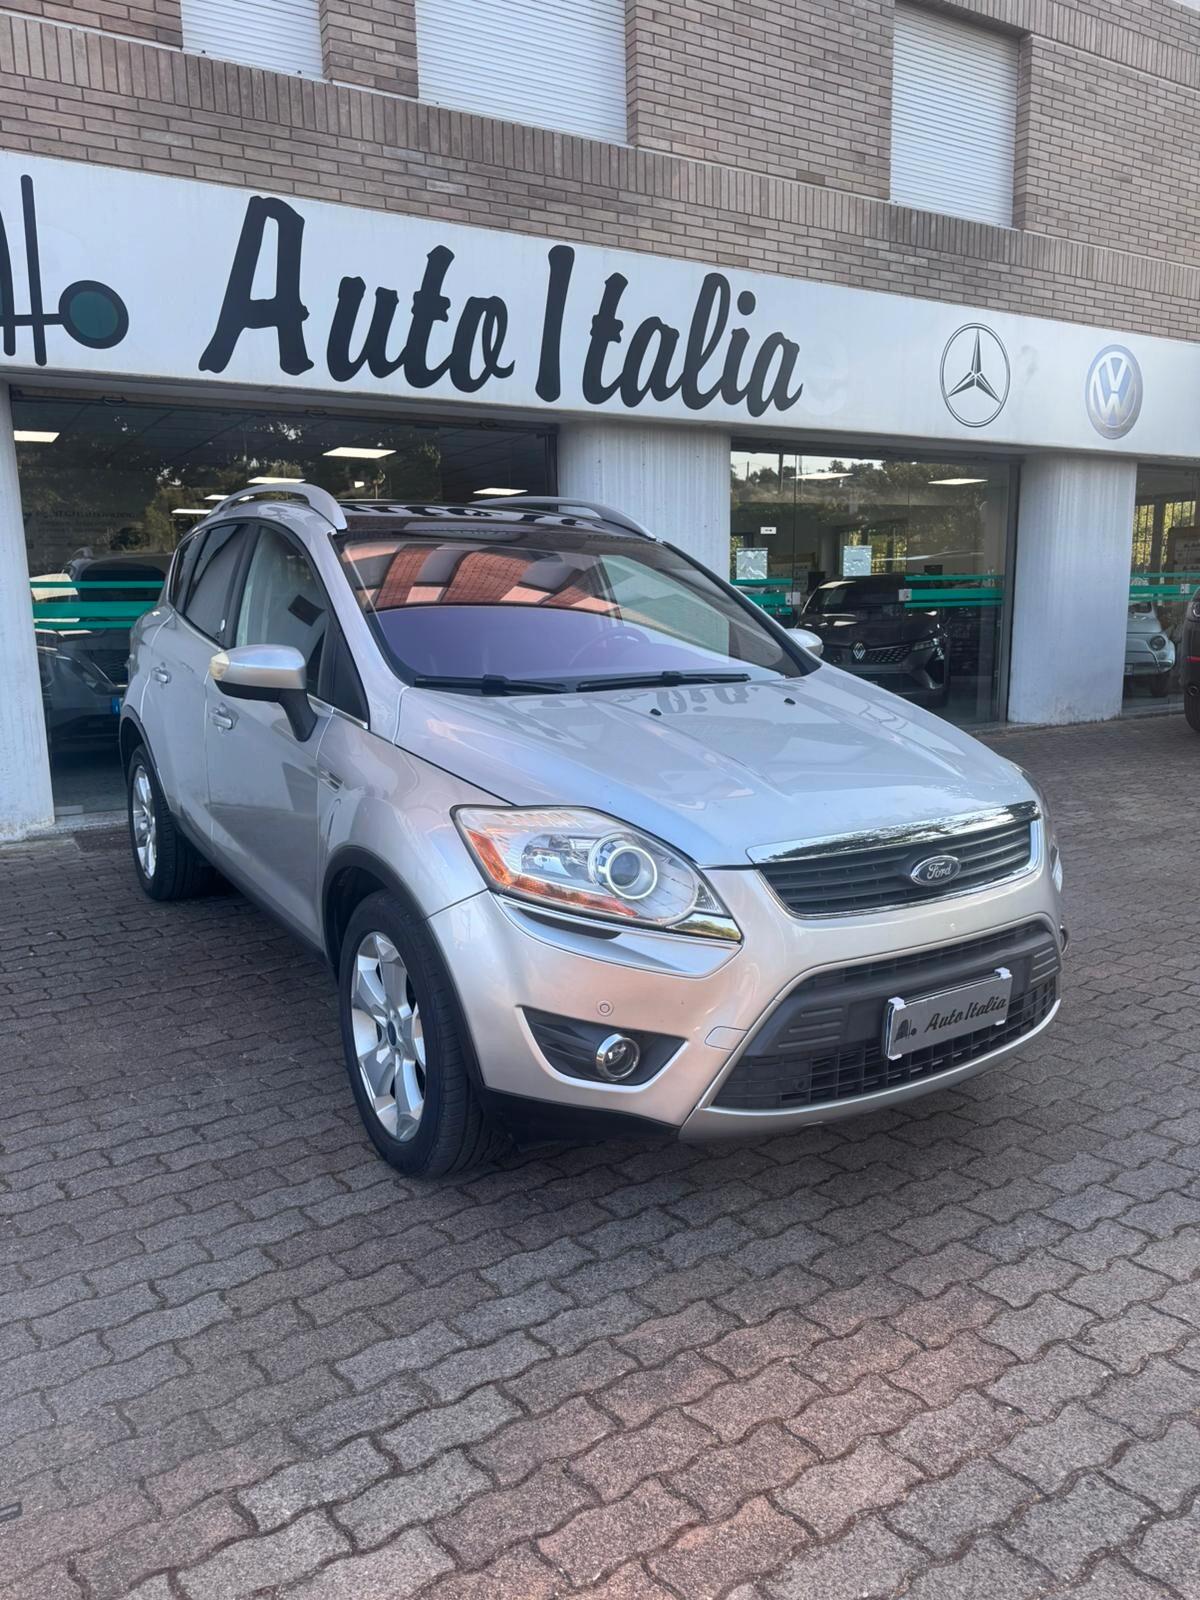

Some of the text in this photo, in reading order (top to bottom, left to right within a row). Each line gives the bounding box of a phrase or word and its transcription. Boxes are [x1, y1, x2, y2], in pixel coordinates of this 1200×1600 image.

[199, 196, 803, 418] Auto Italia
[926, 861, 952, 880] Ford
